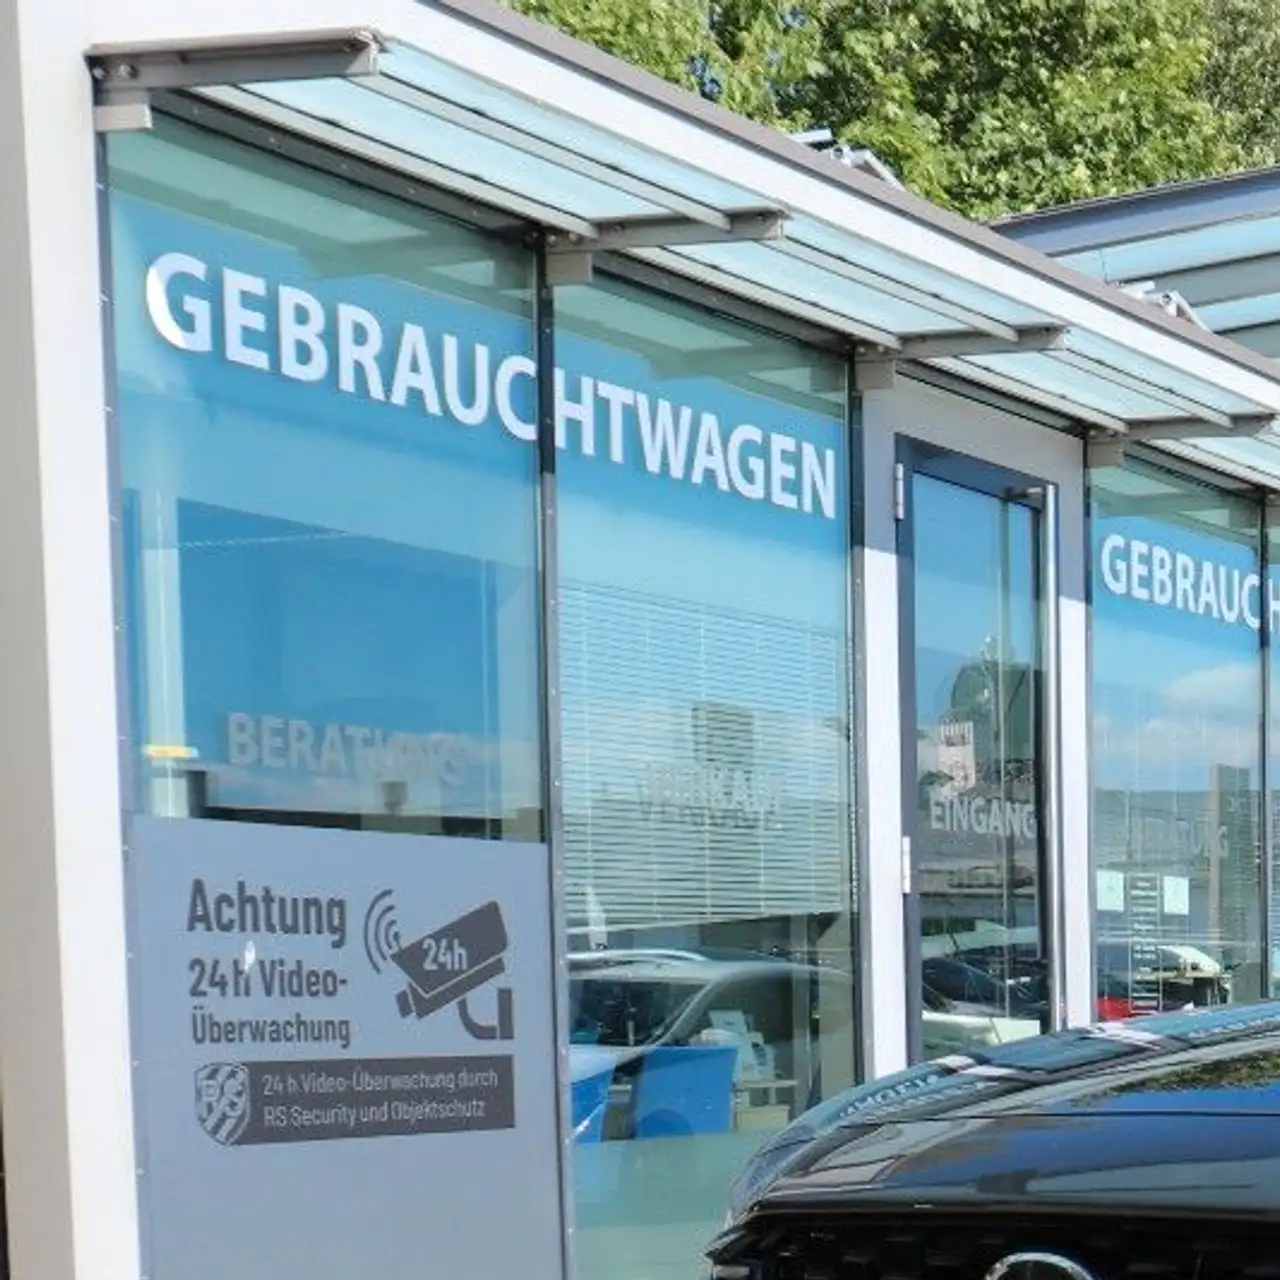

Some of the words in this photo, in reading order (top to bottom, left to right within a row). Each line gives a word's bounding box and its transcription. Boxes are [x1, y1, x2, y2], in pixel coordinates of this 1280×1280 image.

[145, 252, 837, 520] GEBRAUCHTWAGEN
[929, 794, 1037, 838] EINGANG
[187, 879, 347, 949] Achtung
[422, 937, 467, 970] 24h
[259, 958, 347, 998] Video-
[192, 1004, 350, 1049] Überwachung
[458, 1067, 499, 1089] durch
[264, 1105, 287, 1127] RS
[290, 1103, 357, 1128] Security
[360, 1101, 388, 1122] und
[391, 1098, 487, 1124] Objektschutz
